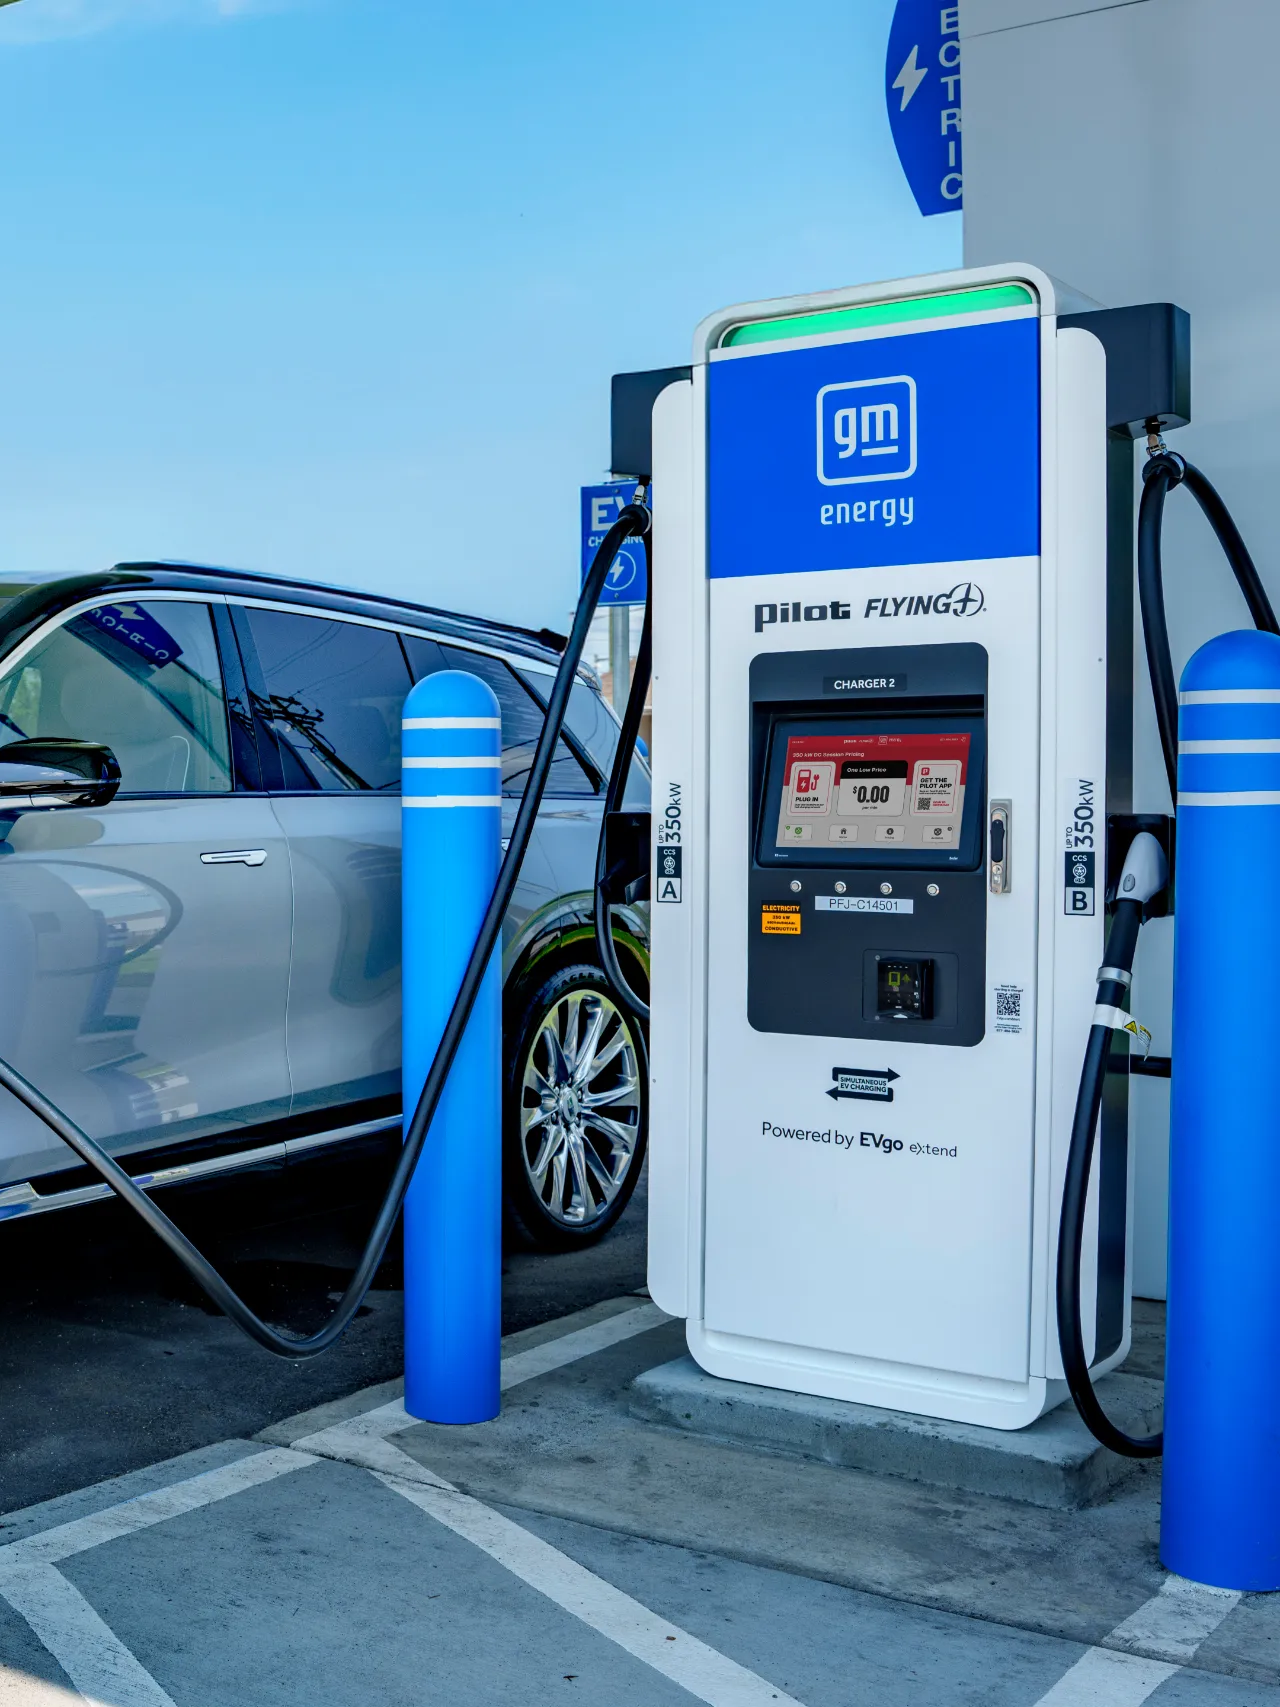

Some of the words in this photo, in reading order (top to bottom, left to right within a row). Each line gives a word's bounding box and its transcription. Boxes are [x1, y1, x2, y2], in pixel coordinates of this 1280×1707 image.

[834, 403, 898, 458] gm
[591, 496, 625, 531] E
[820, 497, 914, 527] energy
[833, 679, 887, 690] CHARGER
[888, 678, 895, 688] 2
[852, 785, 890, 804] $0.00
[658, 824, 664, 834] TO
[1065, 826, 1073, 837] TO
[658, 834, 664, 843] UP
[1065, 839, 1073, 848] UP
[661, 880, 677, 899] A
[829, 898, 899, 911] PFJ-C14501
[1072, 890, 1088, 911] B
[840, 1076, 887, 1086] SIMULTANEOUS
[850, 1083, 887, 1093] CHARGING
[762, 1121, 831, 1144] Powered
[835, 1130, 854, 1149] by
[859, 1131, 904, 1153] EVgo
[909, 1142, 958, 1157] extend
